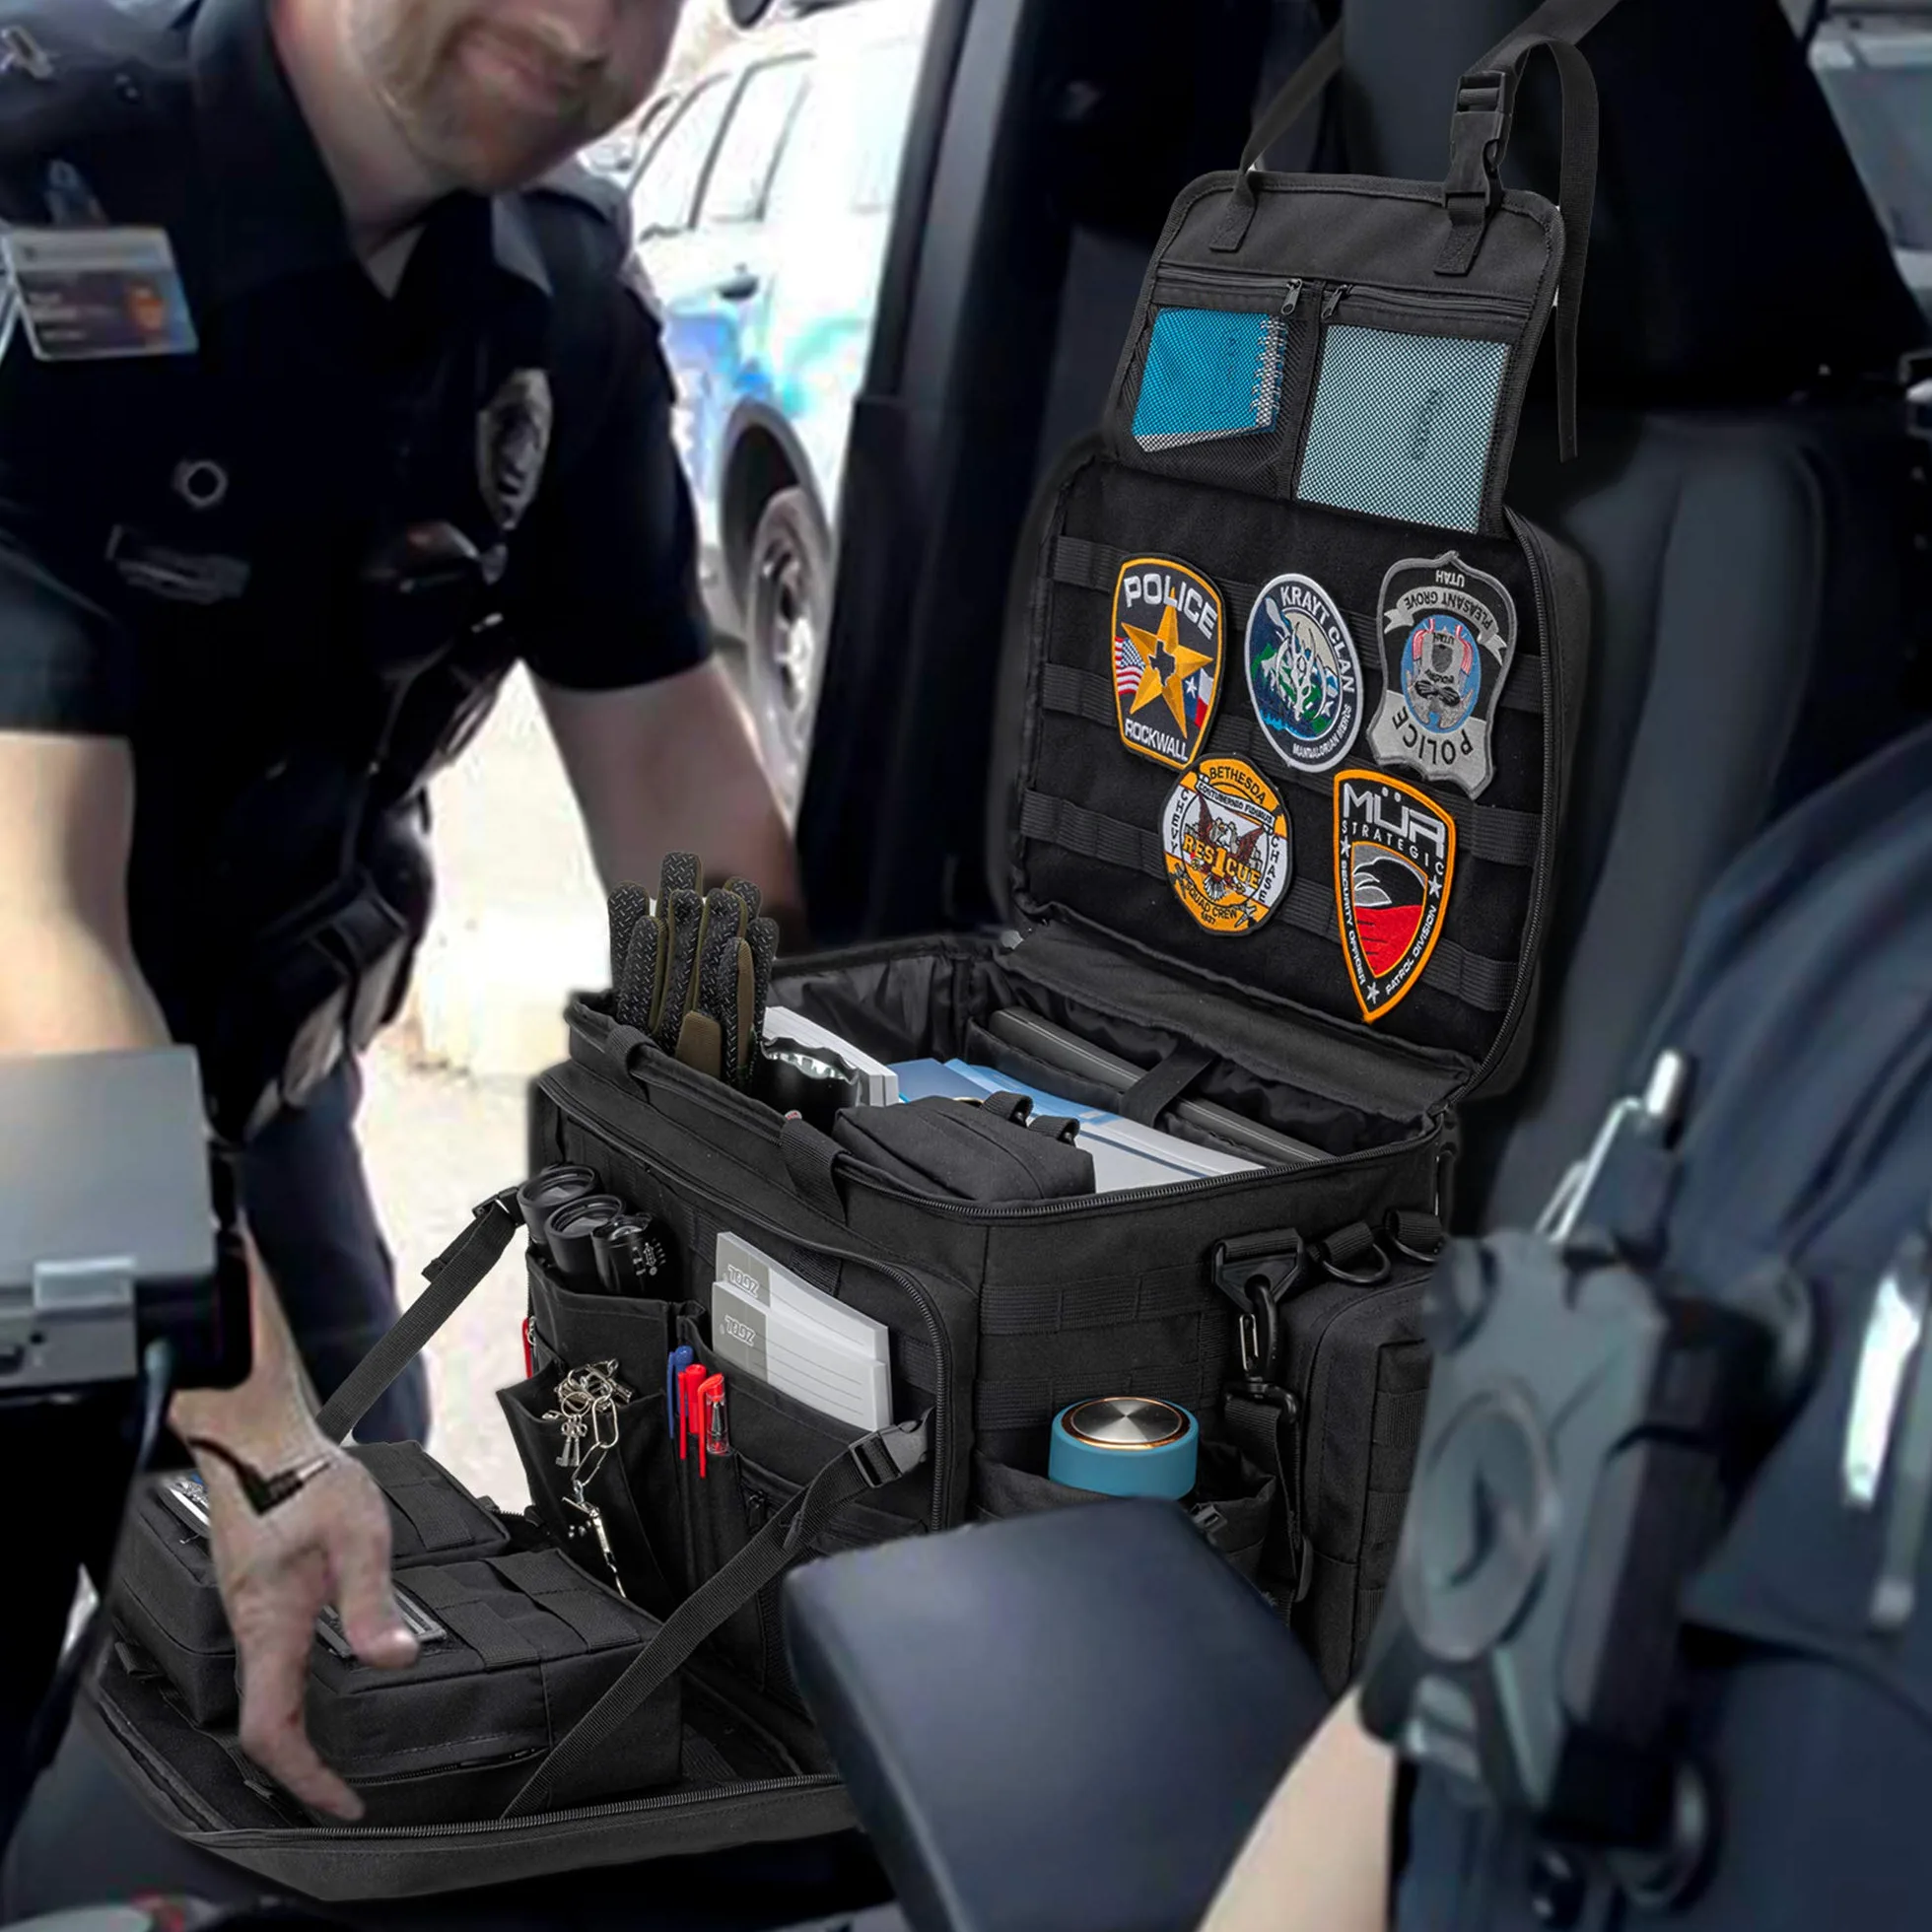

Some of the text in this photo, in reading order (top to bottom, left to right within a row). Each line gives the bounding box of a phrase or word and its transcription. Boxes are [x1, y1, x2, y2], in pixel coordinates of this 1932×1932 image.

[1124, 573, 1217, 640] POLICE
[1435, 570, 1465, 587] UTAH
[1405, 590, 1493, 631] PLEASANT GROVE
[1280, 586, 1355, 693] KRAYT CLAN
[1125, 719, 1189, 762] ROCKWALL
[1392, 706, 1474, 765] POLICE
[1208, 766, 1267, 804] BETHESDA
[1259, 836, 1280, 904] CHASE
[1342, 820, 1445, 875] STRATEGIC
[1212, 906, 1237, 919] CREW
[1341, 860, 1366, 986] SECURITY OFFICER
[1386, 905, 1437, 996] PATROL DIVISION
